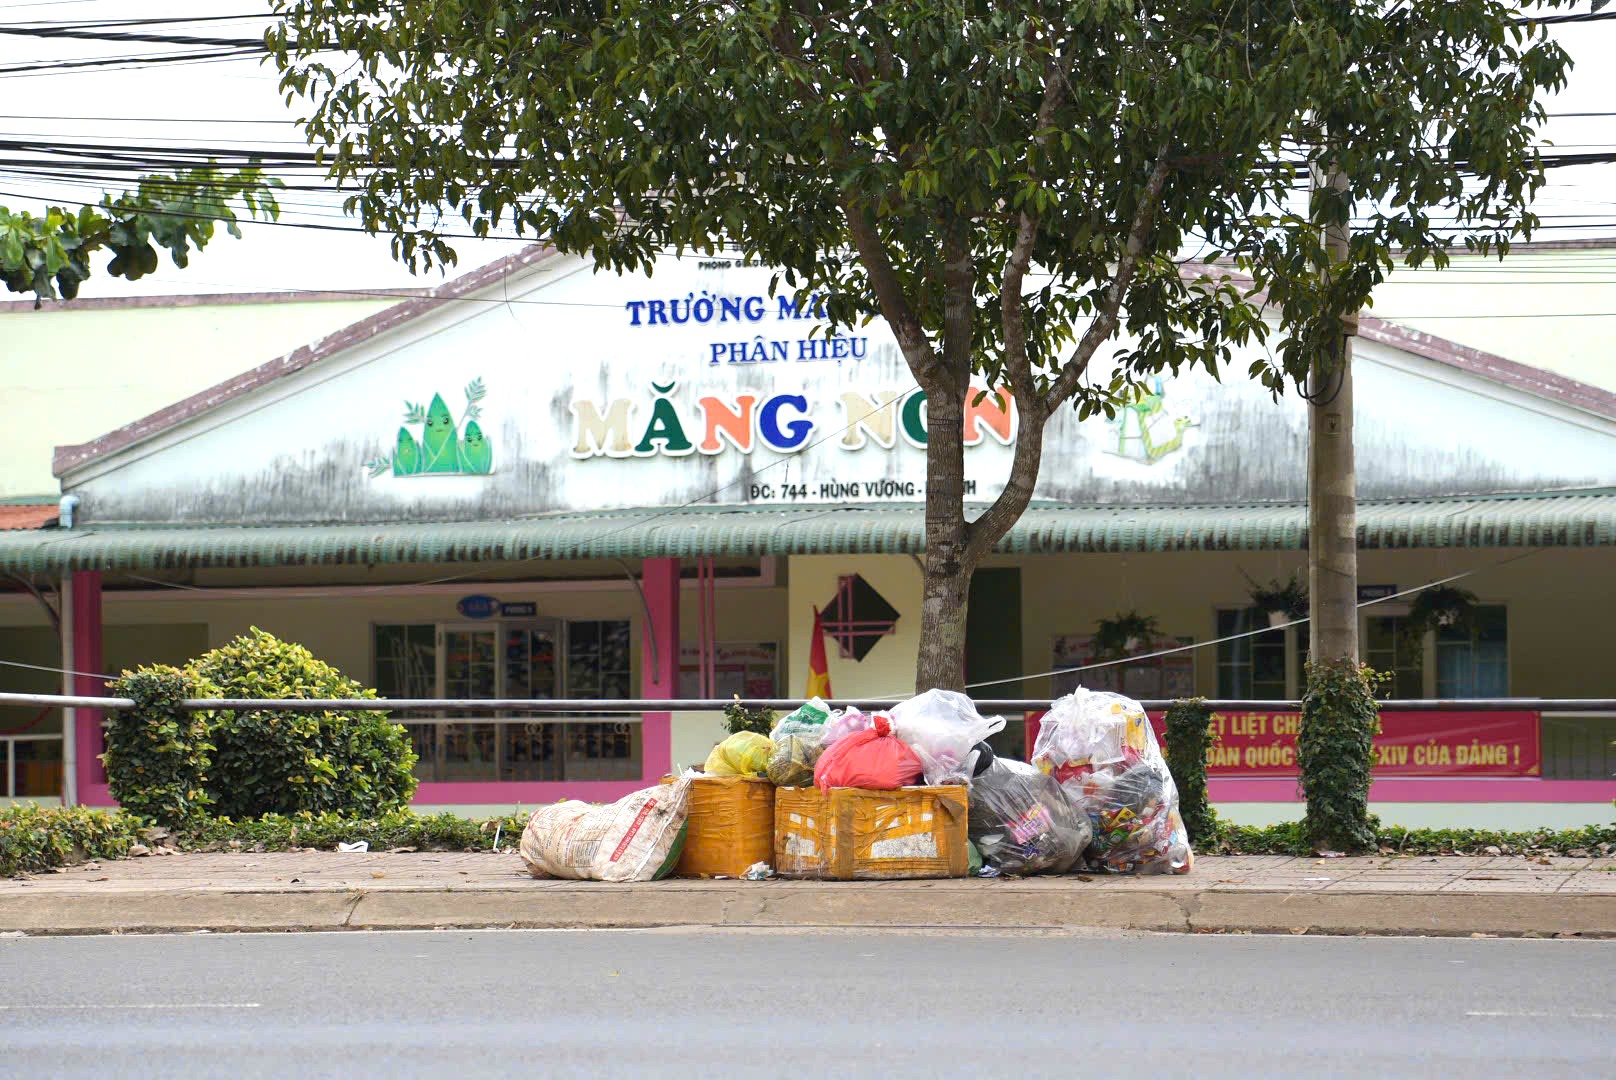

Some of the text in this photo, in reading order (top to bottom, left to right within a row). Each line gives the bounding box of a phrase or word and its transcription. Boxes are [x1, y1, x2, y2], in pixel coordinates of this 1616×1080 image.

[625, 290, 766, 326] TRƯỜNG
[709, 332, 868, 366] PHÂN HIỆU
[572, 380, 815, 454] MĂNG
[781, 483, 807, 500] 744
[820, 477, 860, 499] HÙNG
[865, 480, 915, 498] VƯƠNG
[1231, 712, 1268, 739] LIỆT
[1245, 740, 1294, 768] QUỐC
[1413, 738, 1451, 766] CỦA
[1455, 738, 1508, 766] ĐẢNG
